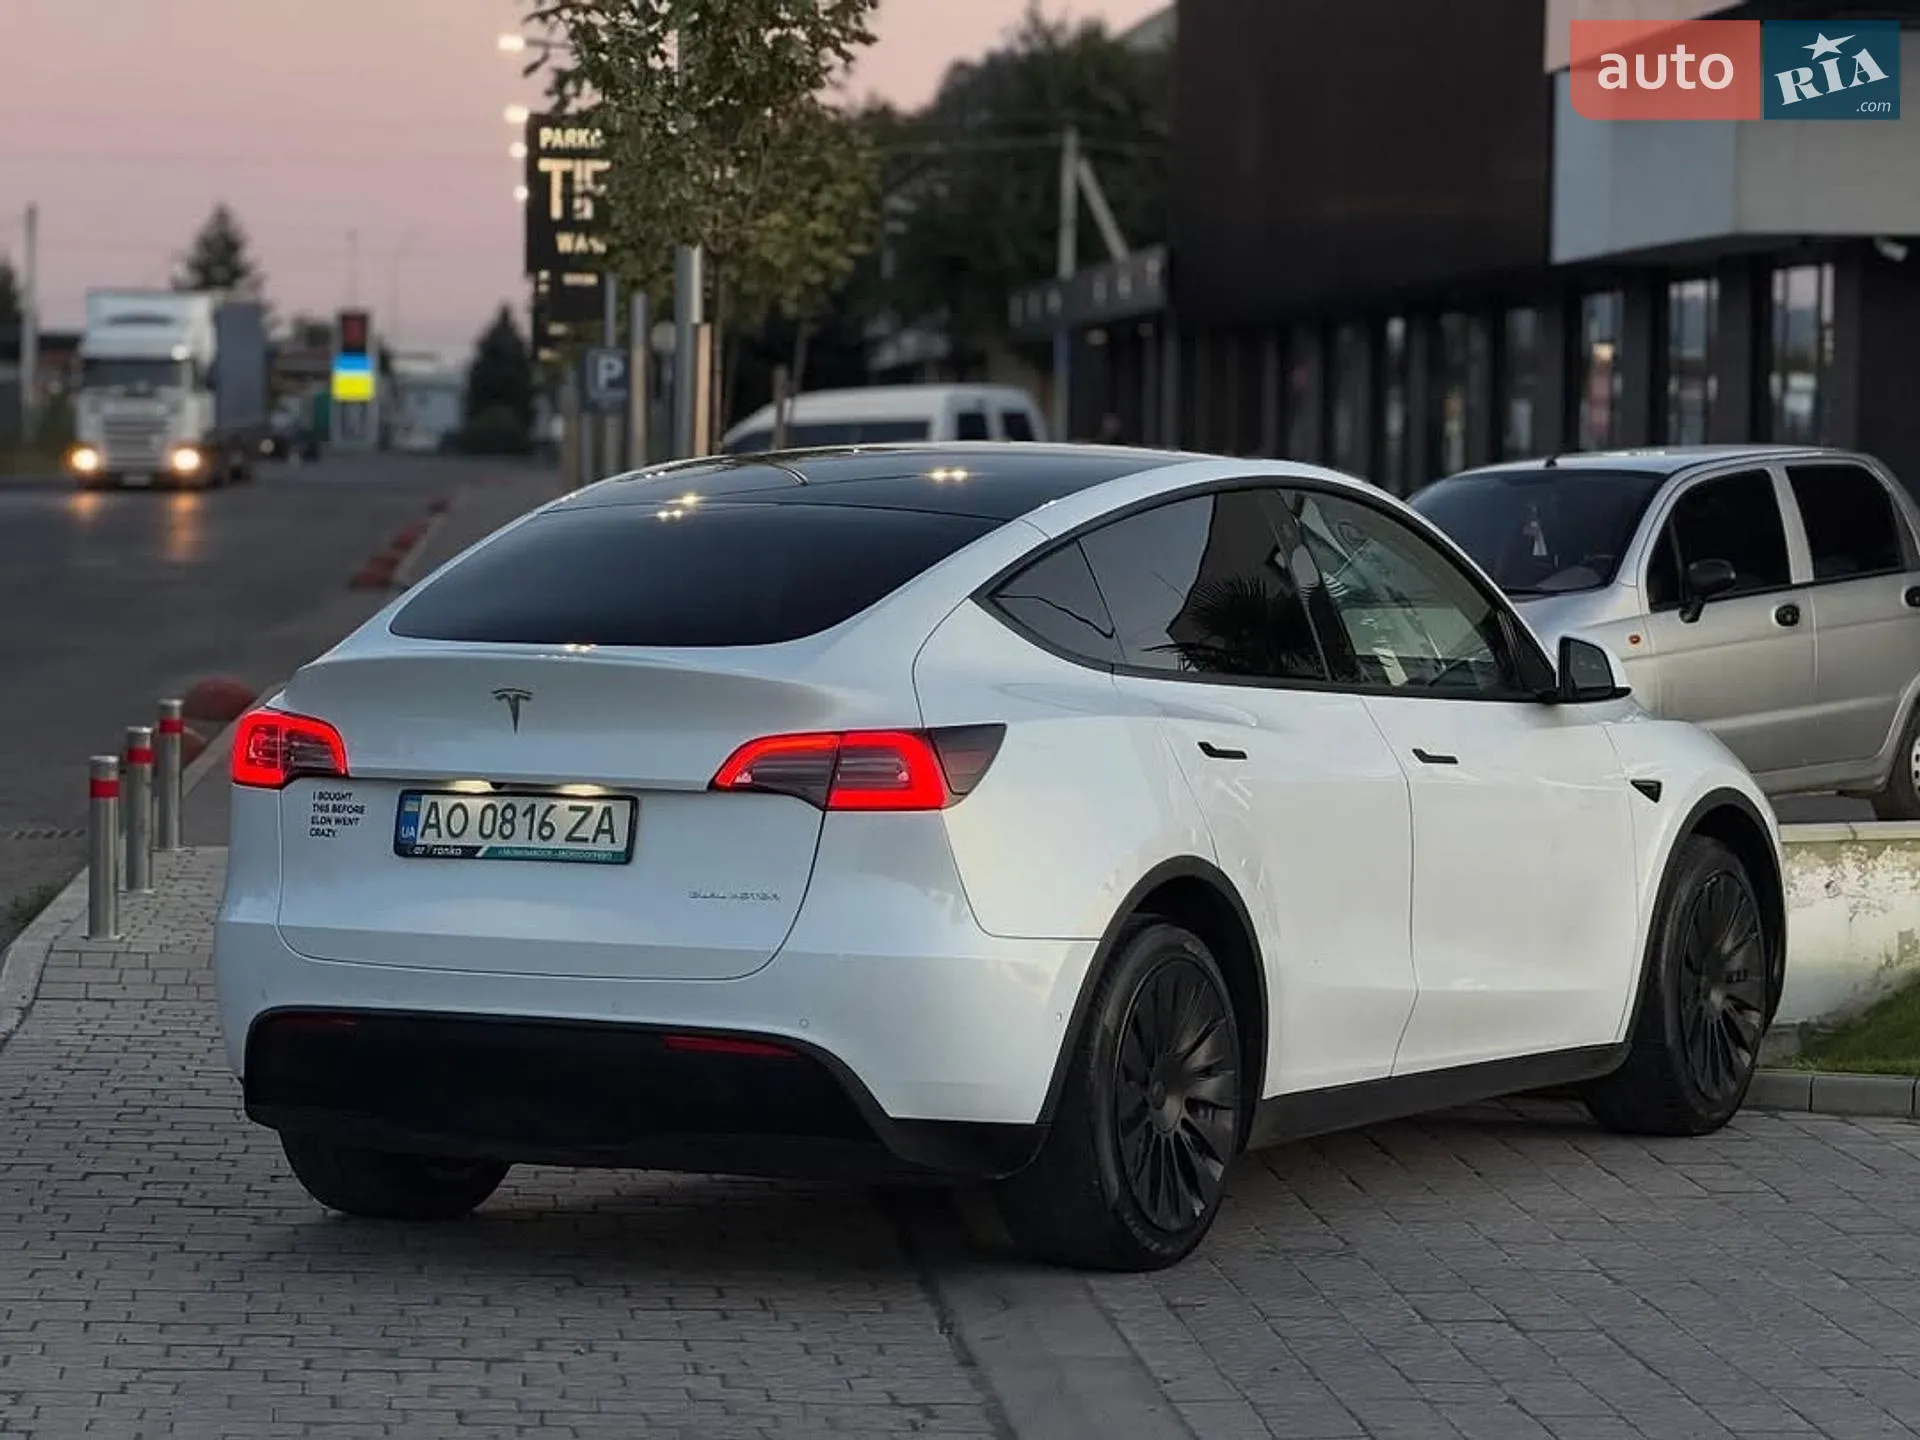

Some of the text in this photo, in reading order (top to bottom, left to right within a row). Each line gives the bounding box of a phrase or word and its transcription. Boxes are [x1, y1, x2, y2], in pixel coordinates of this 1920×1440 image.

[401, 825, 416, 840] UA
[420, 801, 616, 844] AO 0816 ZA
